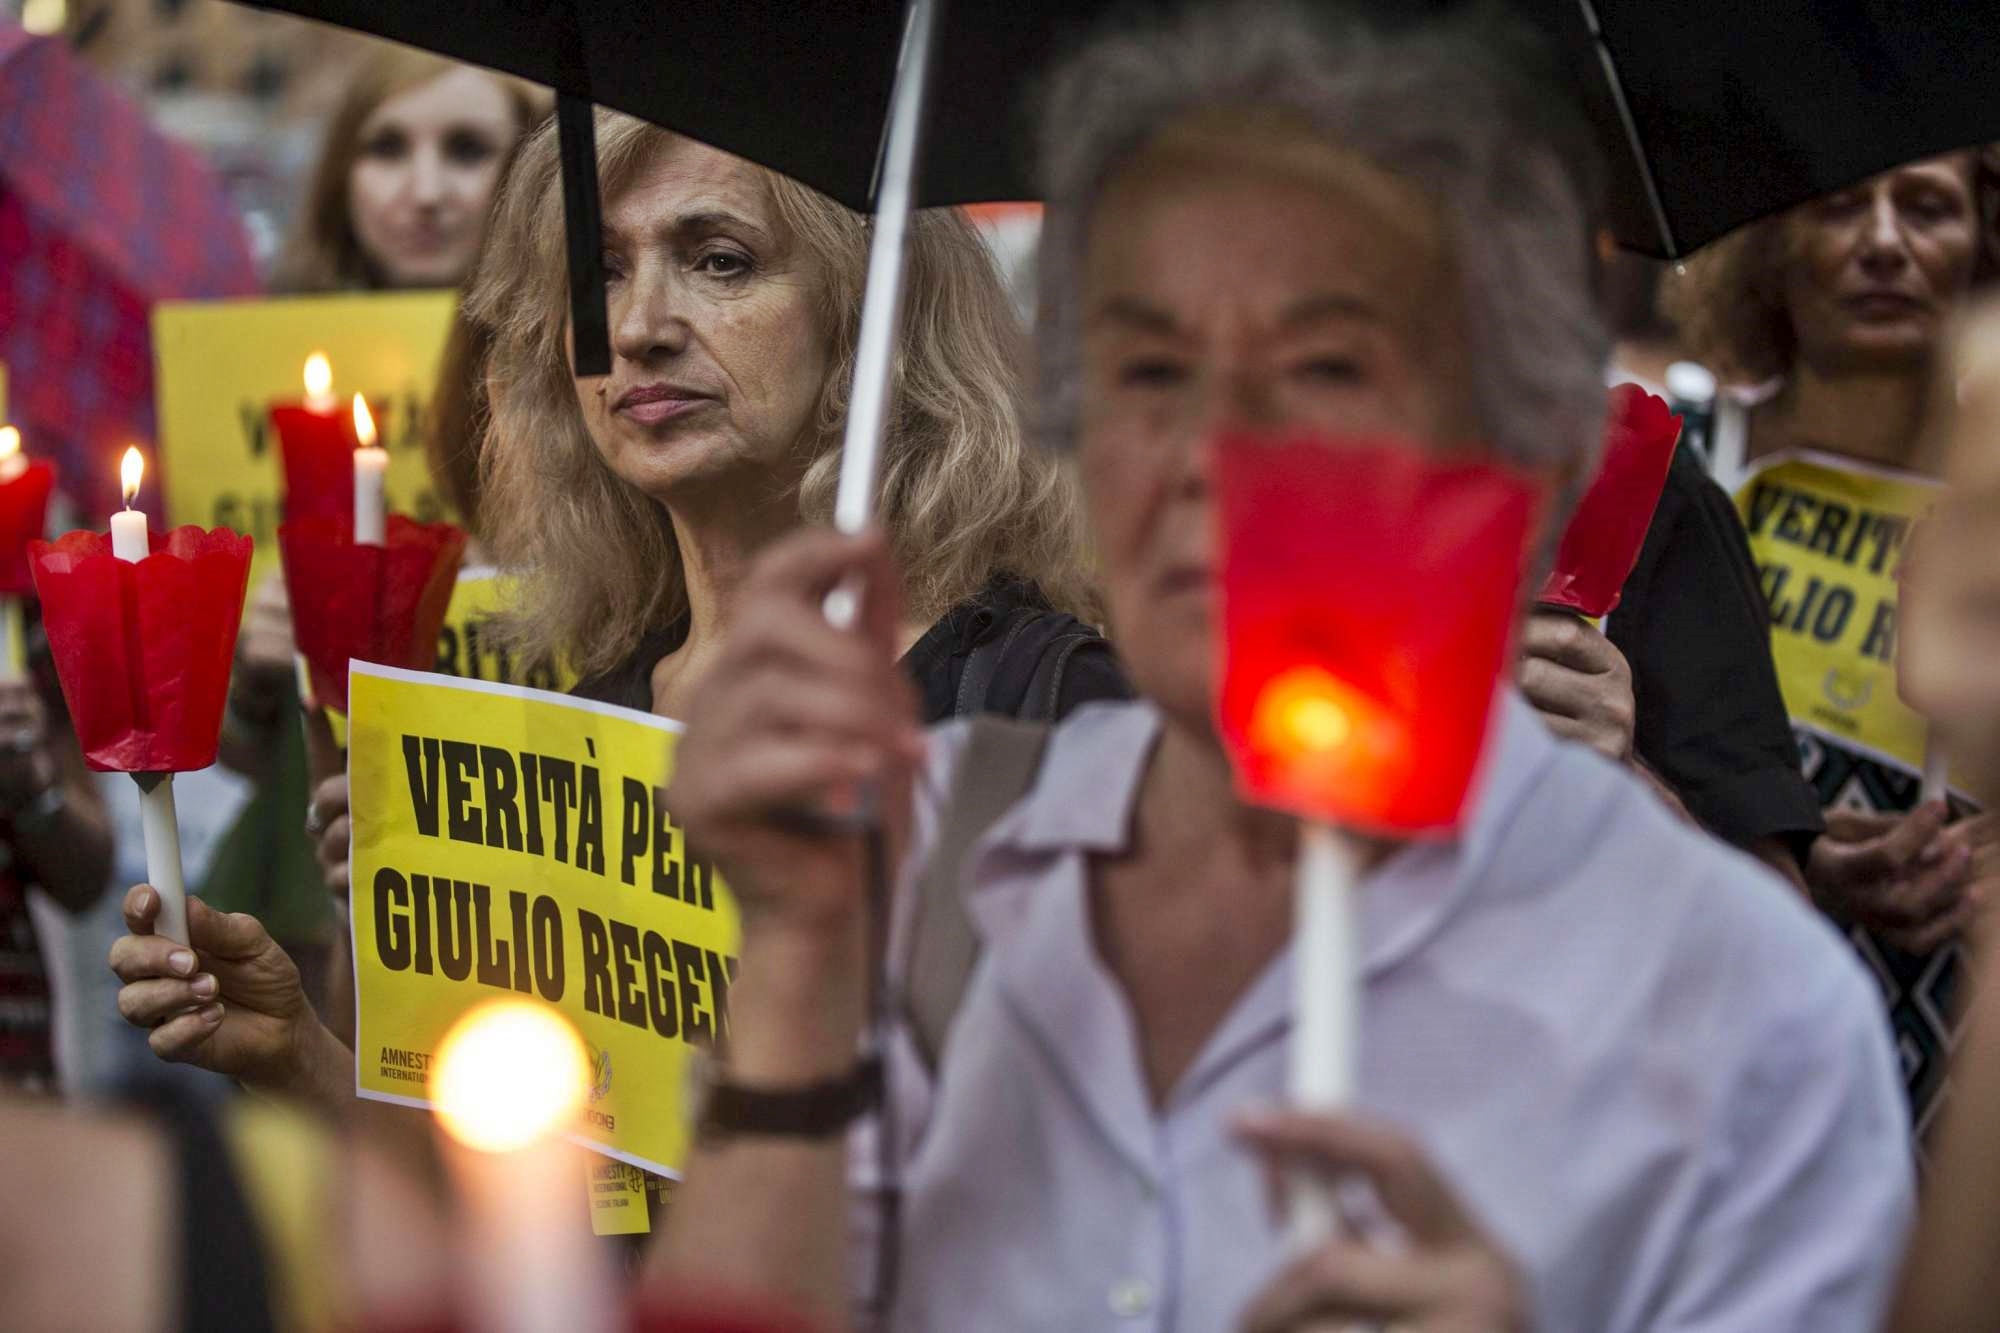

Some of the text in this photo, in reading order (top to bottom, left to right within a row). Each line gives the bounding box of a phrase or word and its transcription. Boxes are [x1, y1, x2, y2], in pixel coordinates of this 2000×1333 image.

[1749, 484, 1911, 575] VERIT
[401, 734, 606, 876] VERITÀ
[373, 867, 738, 1048] GIULIO REGEN
[380, 1047, 431, 1070] AMNEST
[380, 1066, 425, 1083] INTERNATIO
